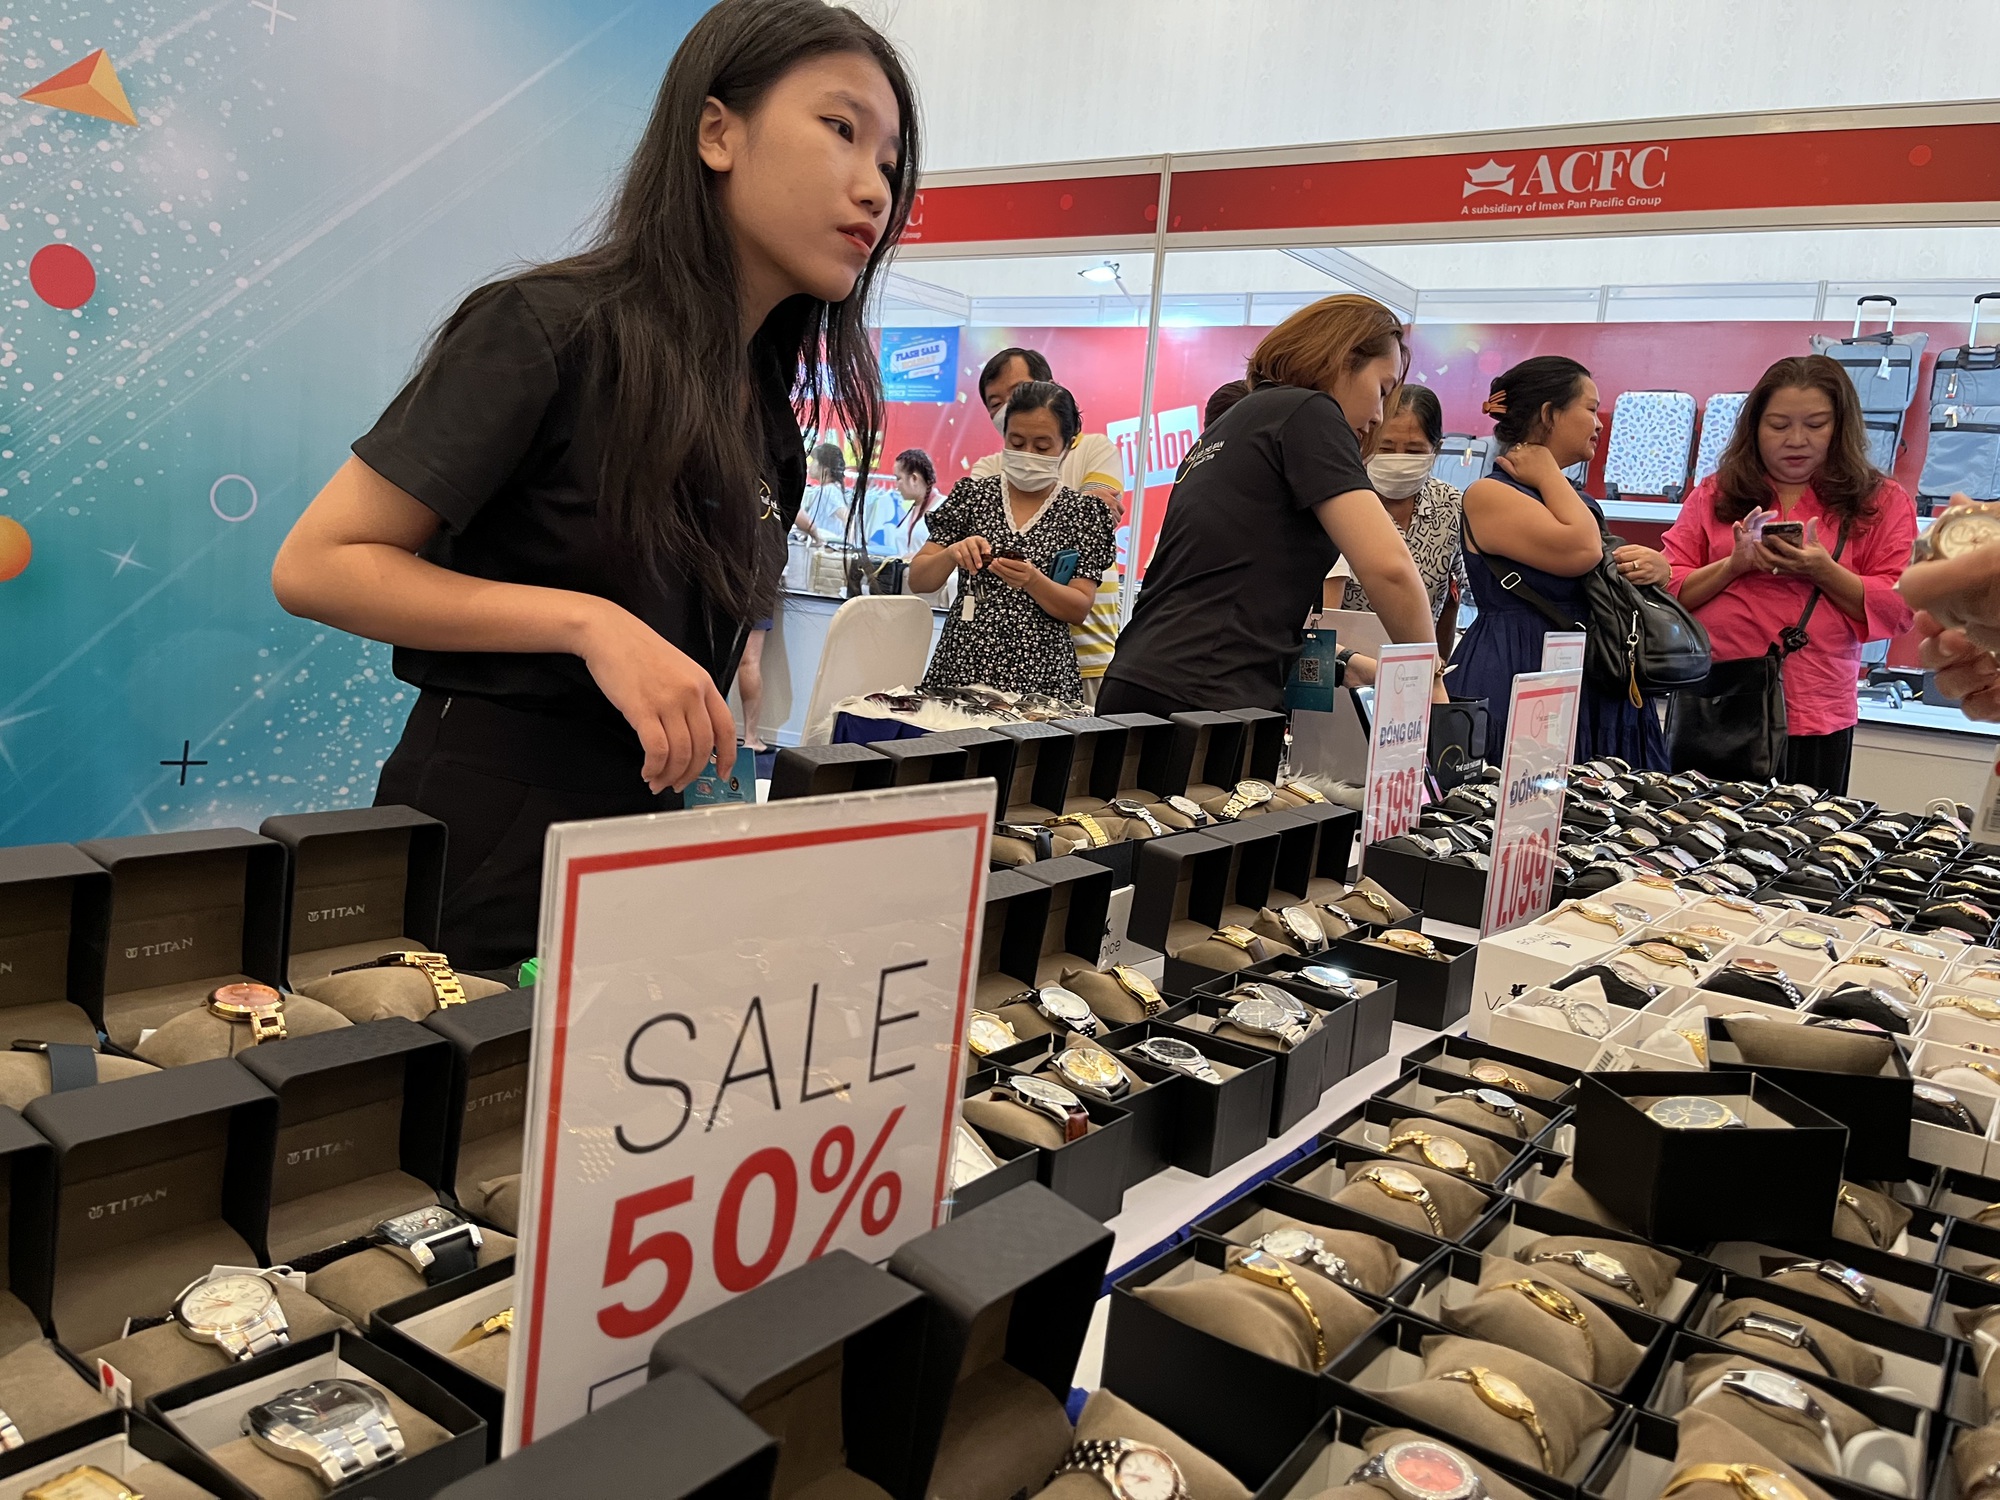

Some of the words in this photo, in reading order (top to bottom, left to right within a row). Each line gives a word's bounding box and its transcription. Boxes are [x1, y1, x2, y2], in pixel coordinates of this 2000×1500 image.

[1519, 145, 1670, 196] ACFC
[1461, 205, 1470, 215] A
[1471, 202, 1523, 215] subsidiary
[1525, 201, 1537, 212] of
[1538, 199, 1565, 211] Imex
[1567, 198, 1587, 209] Pan
[1590, 196, 1625, 208] Pacific
[1627, 195, 1662, 208] Group
[920, 344, 940, 356] SALE
[1115, 428, 1194, 477] fiflo
[320, 903, 366, 921] TITAN
[141, 936, 194, 958] TITAN
[613, 958, 929, 1155] SALE
[478, 1085, 524, 1107] TITAN
[300, 1137, 355, 1163] TITAN
[105, 1185, 168, 1218] TITAN
[596, 1103, 907, 1340] 50%
